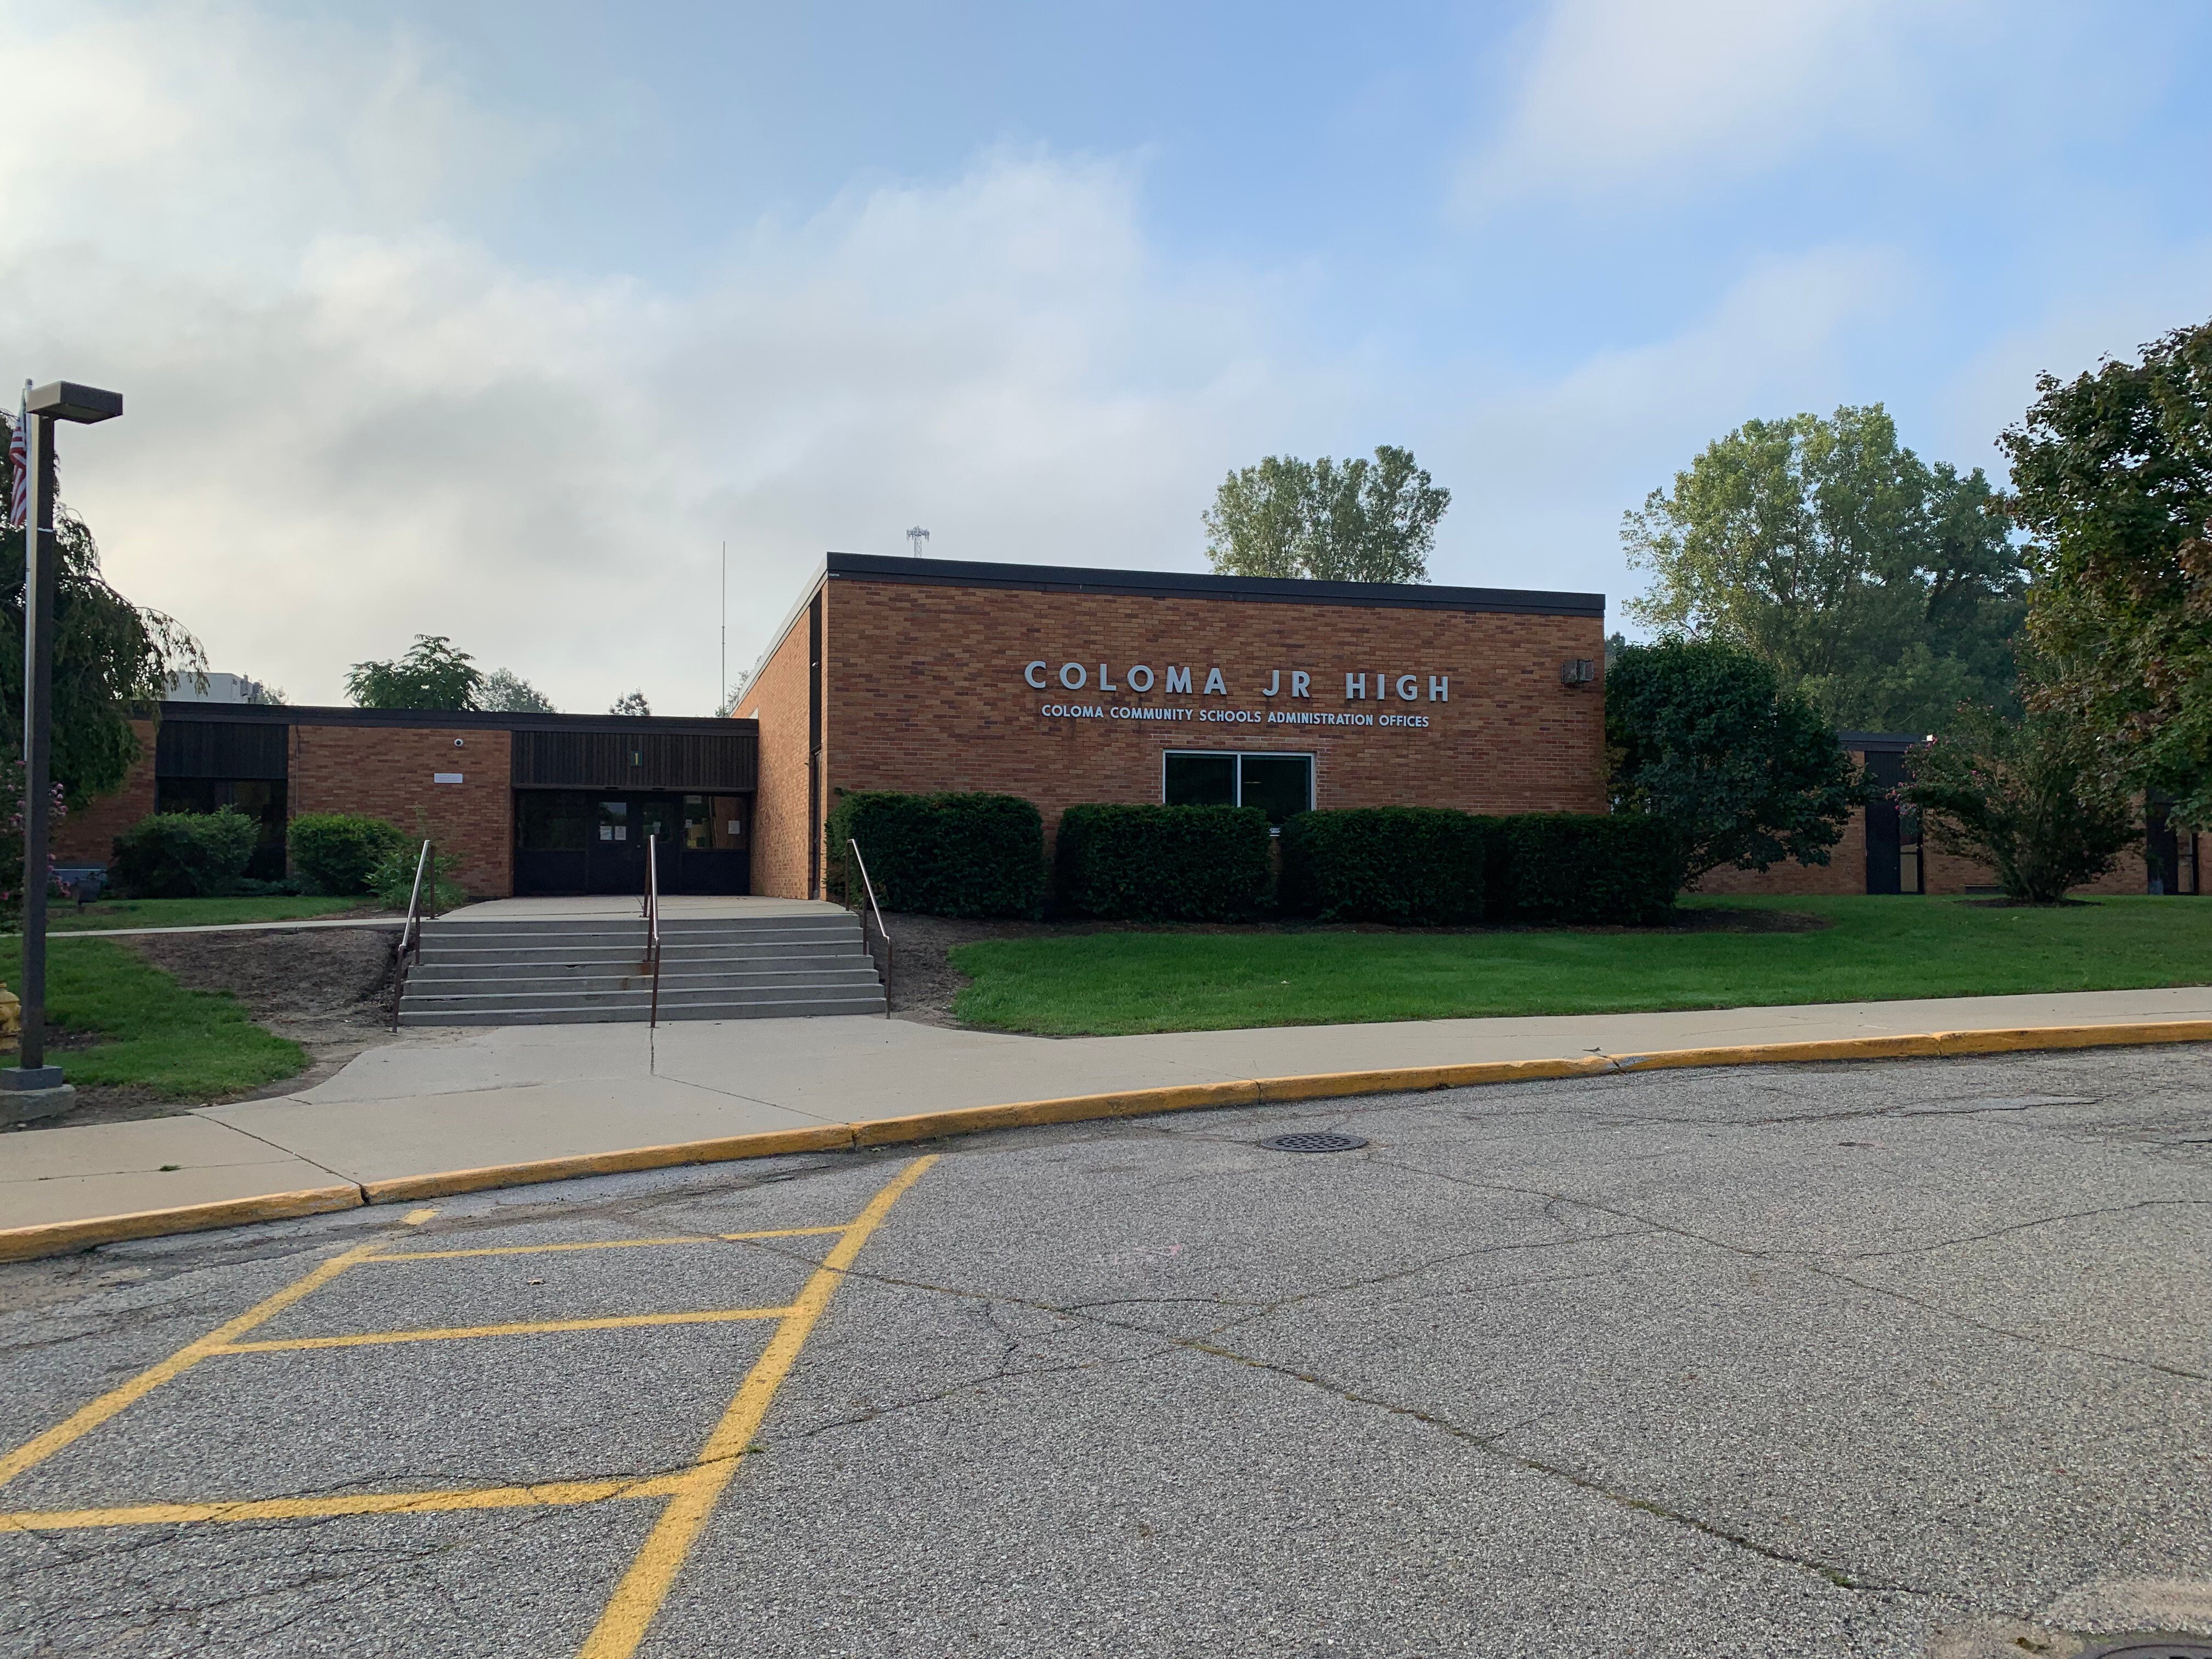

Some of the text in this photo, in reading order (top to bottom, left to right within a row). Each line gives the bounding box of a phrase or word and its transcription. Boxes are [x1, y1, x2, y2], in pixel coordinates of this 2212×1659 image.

[1024, 661, 1448, 702] COLOMA JR HIGH
[1042, 704, 1429, 727] COLOMA COMMUNITY SCHOOLS ADMINISTRATION OFFICES
